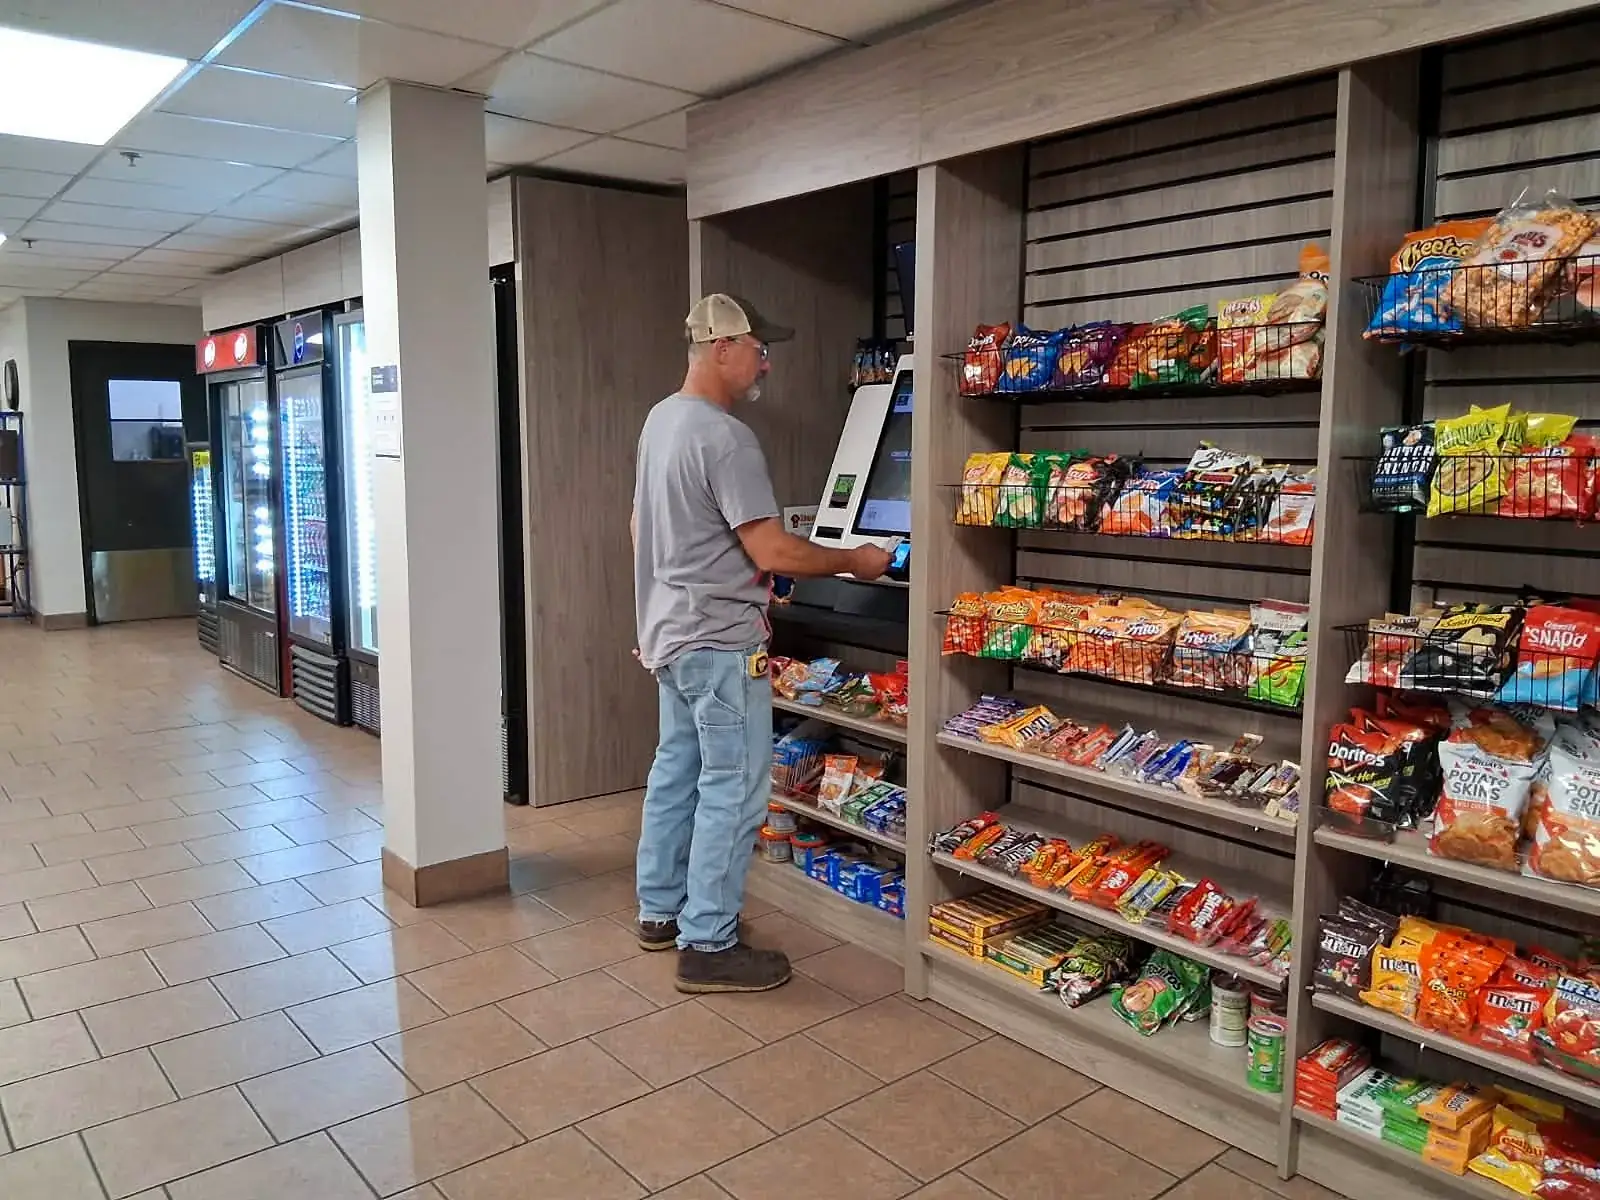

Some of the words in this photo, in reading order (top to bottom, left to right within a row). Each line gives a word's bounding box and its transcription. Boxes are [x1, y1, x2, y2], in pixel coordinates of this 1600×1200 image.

[1328, 741, 1386, 767] Doritos
[1448, 769, 1510, 789] POTATO
[1451, 781, 1501, 801] SKINS
